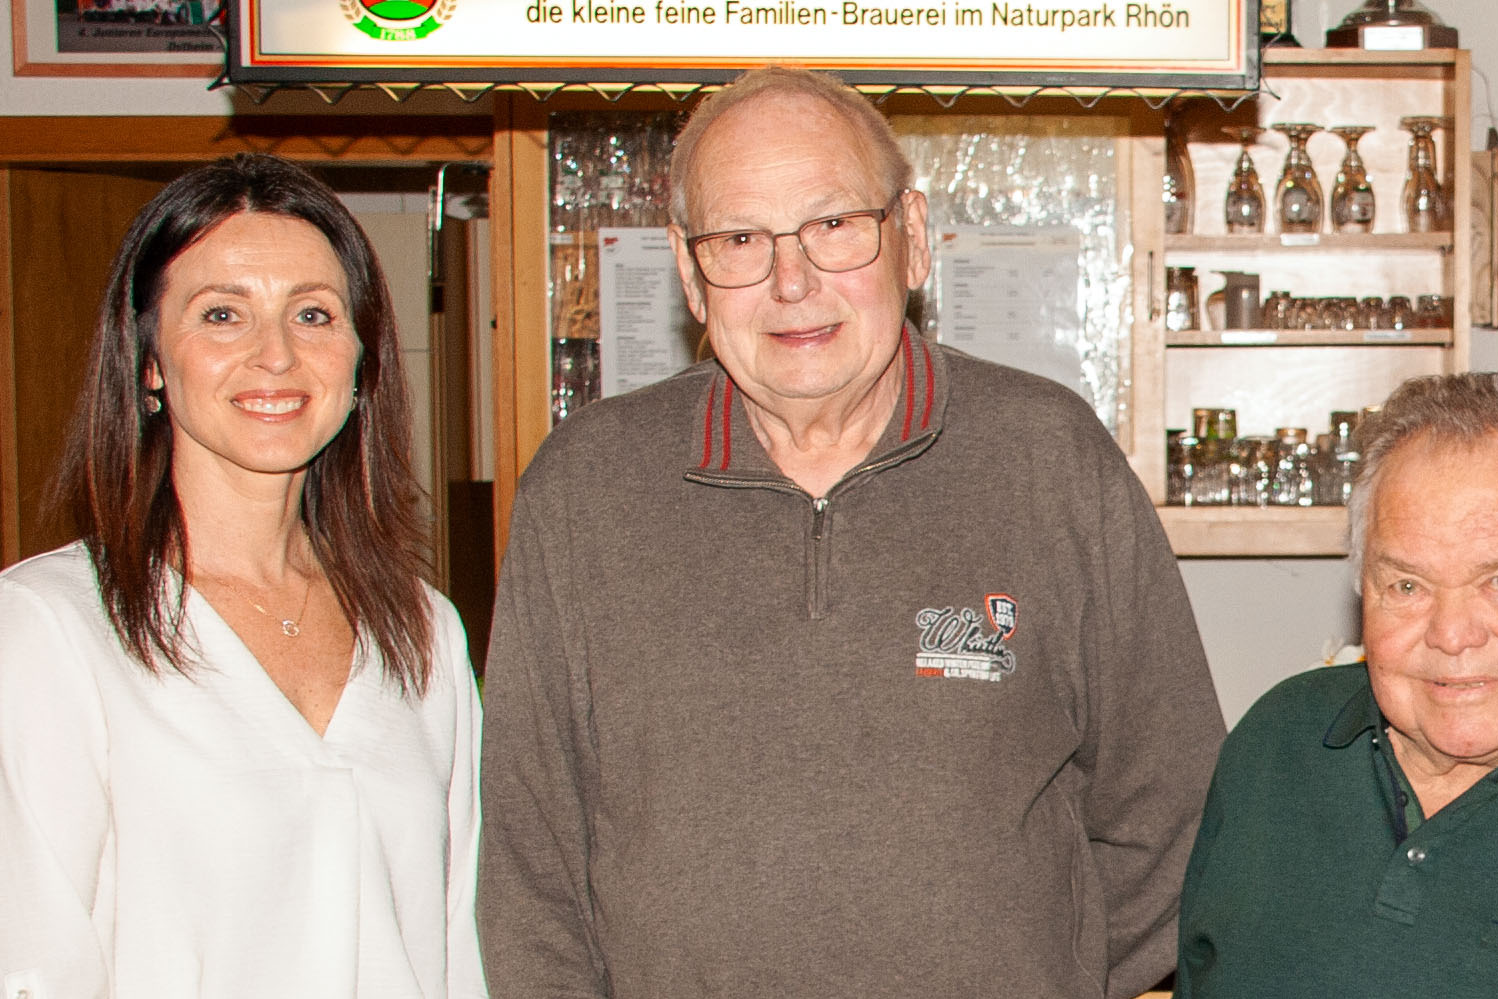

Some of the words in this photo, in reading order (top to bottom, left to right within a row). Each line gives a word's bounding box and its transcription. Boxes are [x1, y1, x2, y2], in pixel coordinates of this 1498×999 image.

[526, 1, 563, 24] die
[571, 1, 646, 25] kleine
[654, 1, 716, 25] feine
[954, 2, 983, 26] im
[991, 3, 1117, 31] Naturpark
[1126, 4, 1190, 28] Rhön
